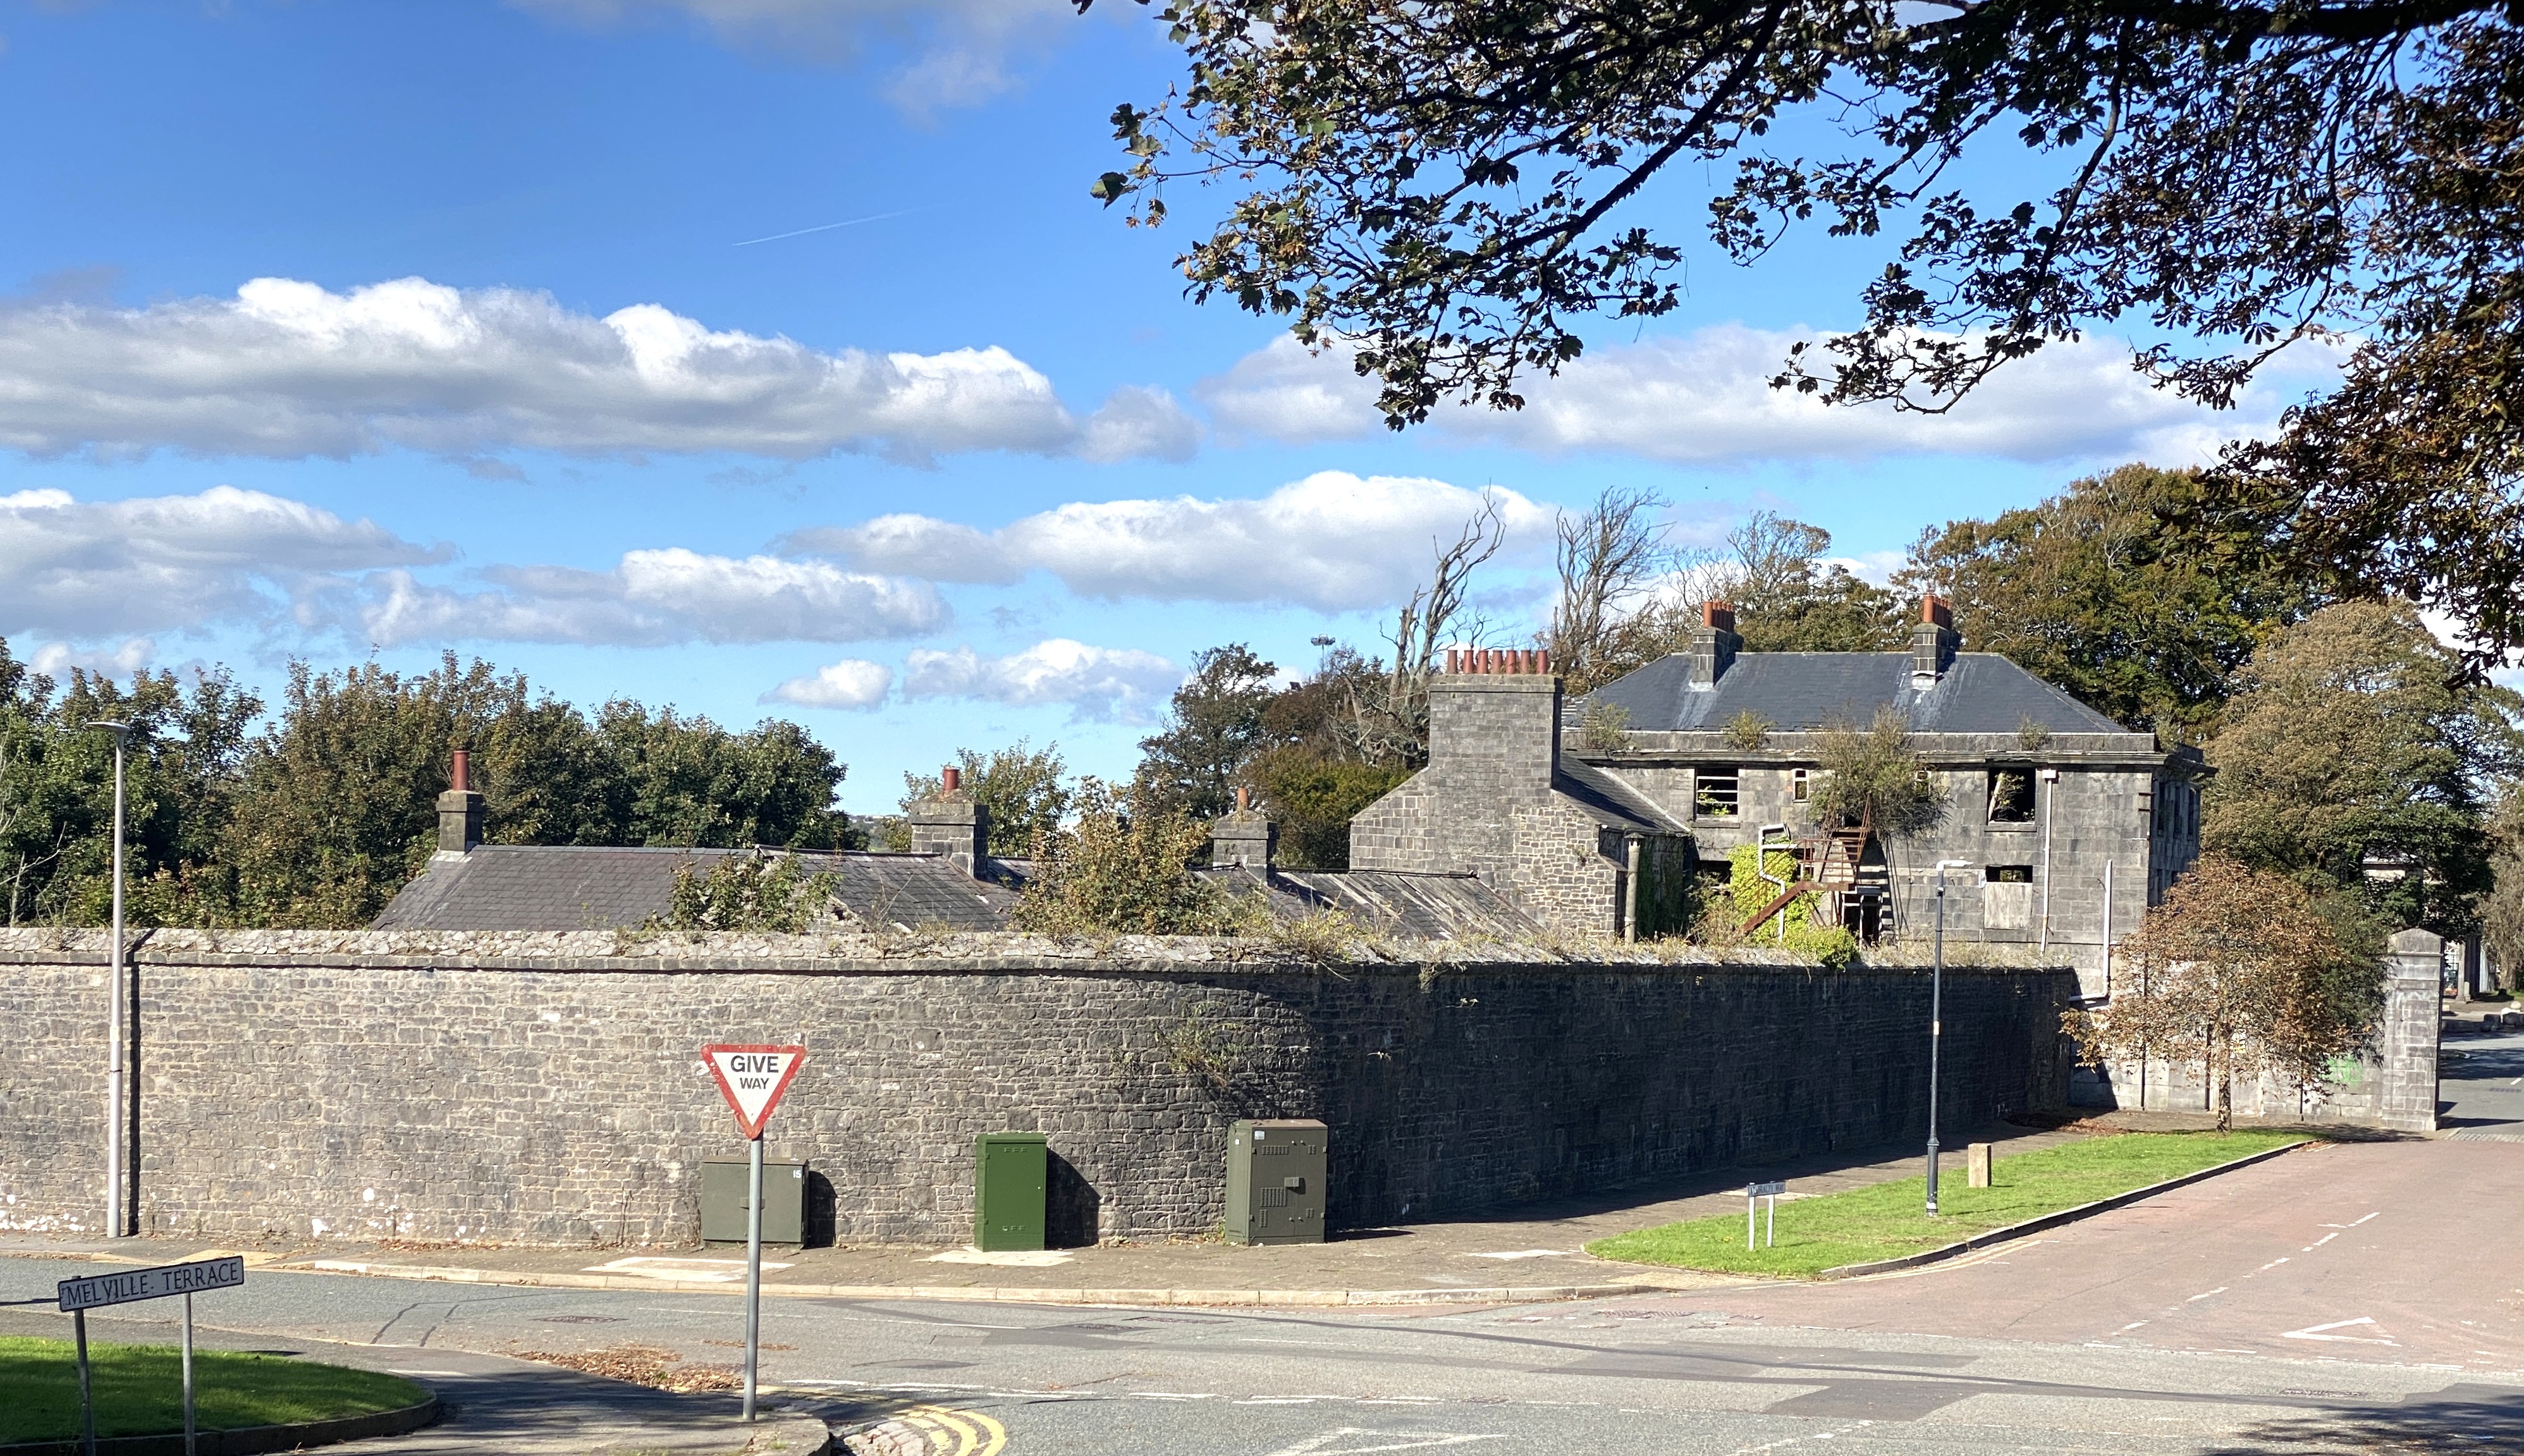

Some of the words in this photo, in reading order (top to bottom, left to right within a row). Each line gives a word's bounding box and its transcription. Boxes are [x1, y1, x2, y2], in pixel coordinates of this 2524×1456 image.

[730, 1055, 779, 1074] GIVE
[740, 1077, 769, 1089] WAY
[793, 1170, 802, 1178] 15
[65, 1275, 149, 1306] MELVILLE
[162, 1262, 238, 1290] TERRACE
